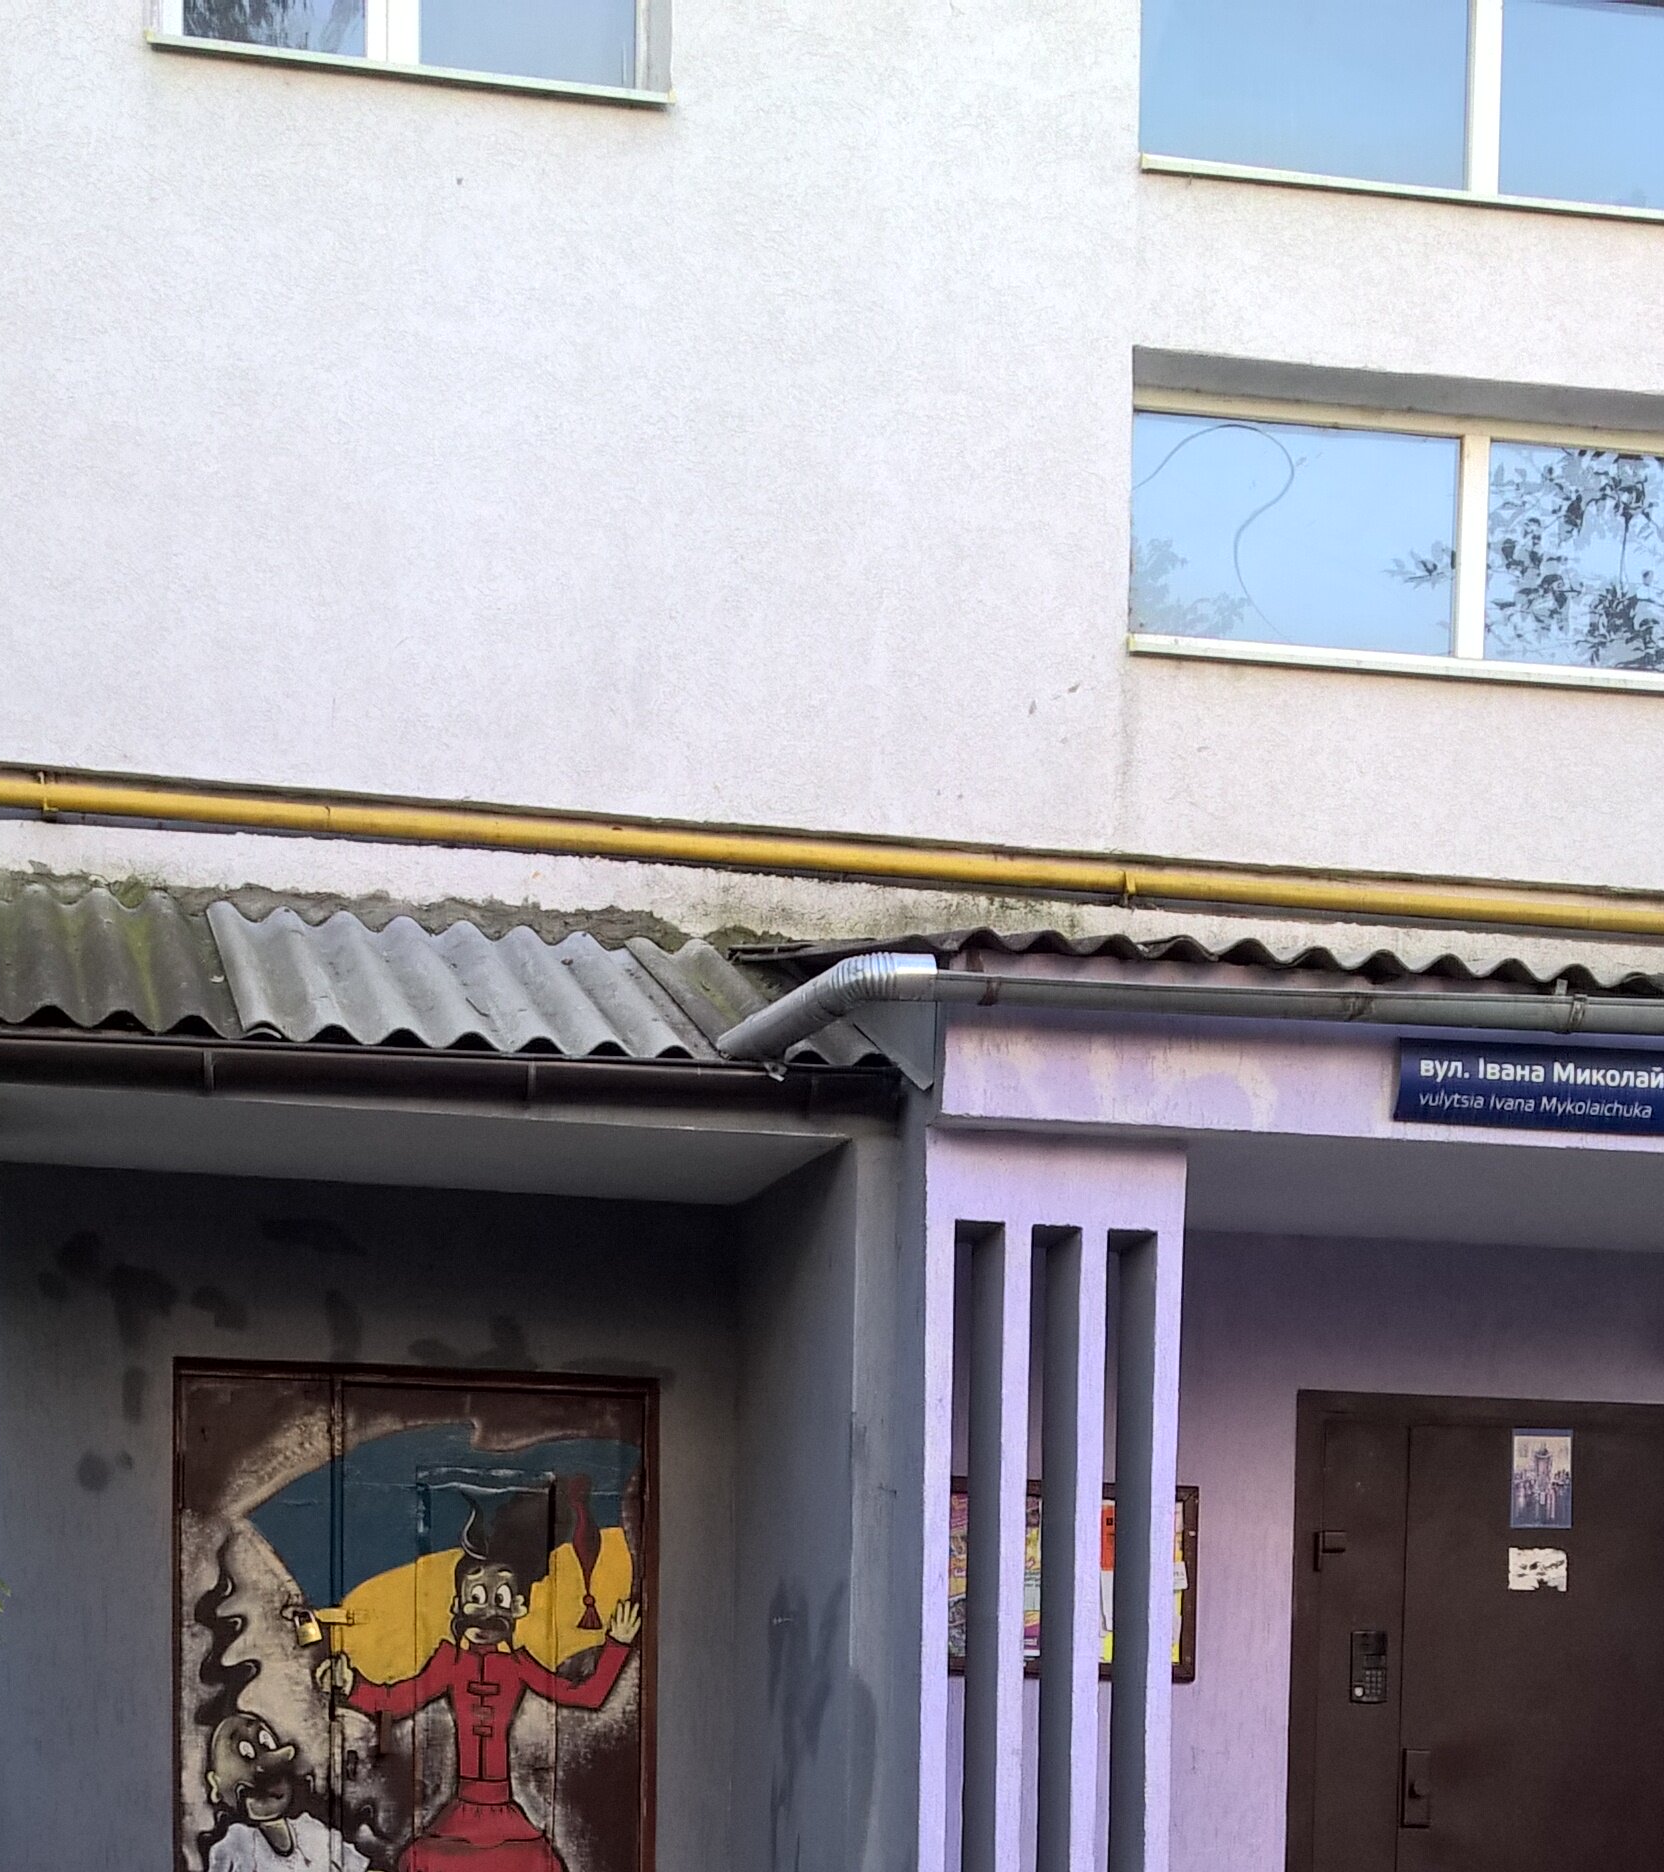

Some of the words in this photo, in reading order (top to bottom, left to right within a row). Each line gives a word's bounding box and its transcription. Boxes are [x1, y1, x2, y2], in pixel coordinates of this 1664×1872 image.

[1419, 1058, 1470, 1083] вул.
[1478, 1057, 1545, 1083] Івана
[1419, 1089, 1485, 1110] vulytsia
[1489, 1093, 1536, 1113] Ivana
[1540, 1096, 1653, 1119] Mykolaichuka
